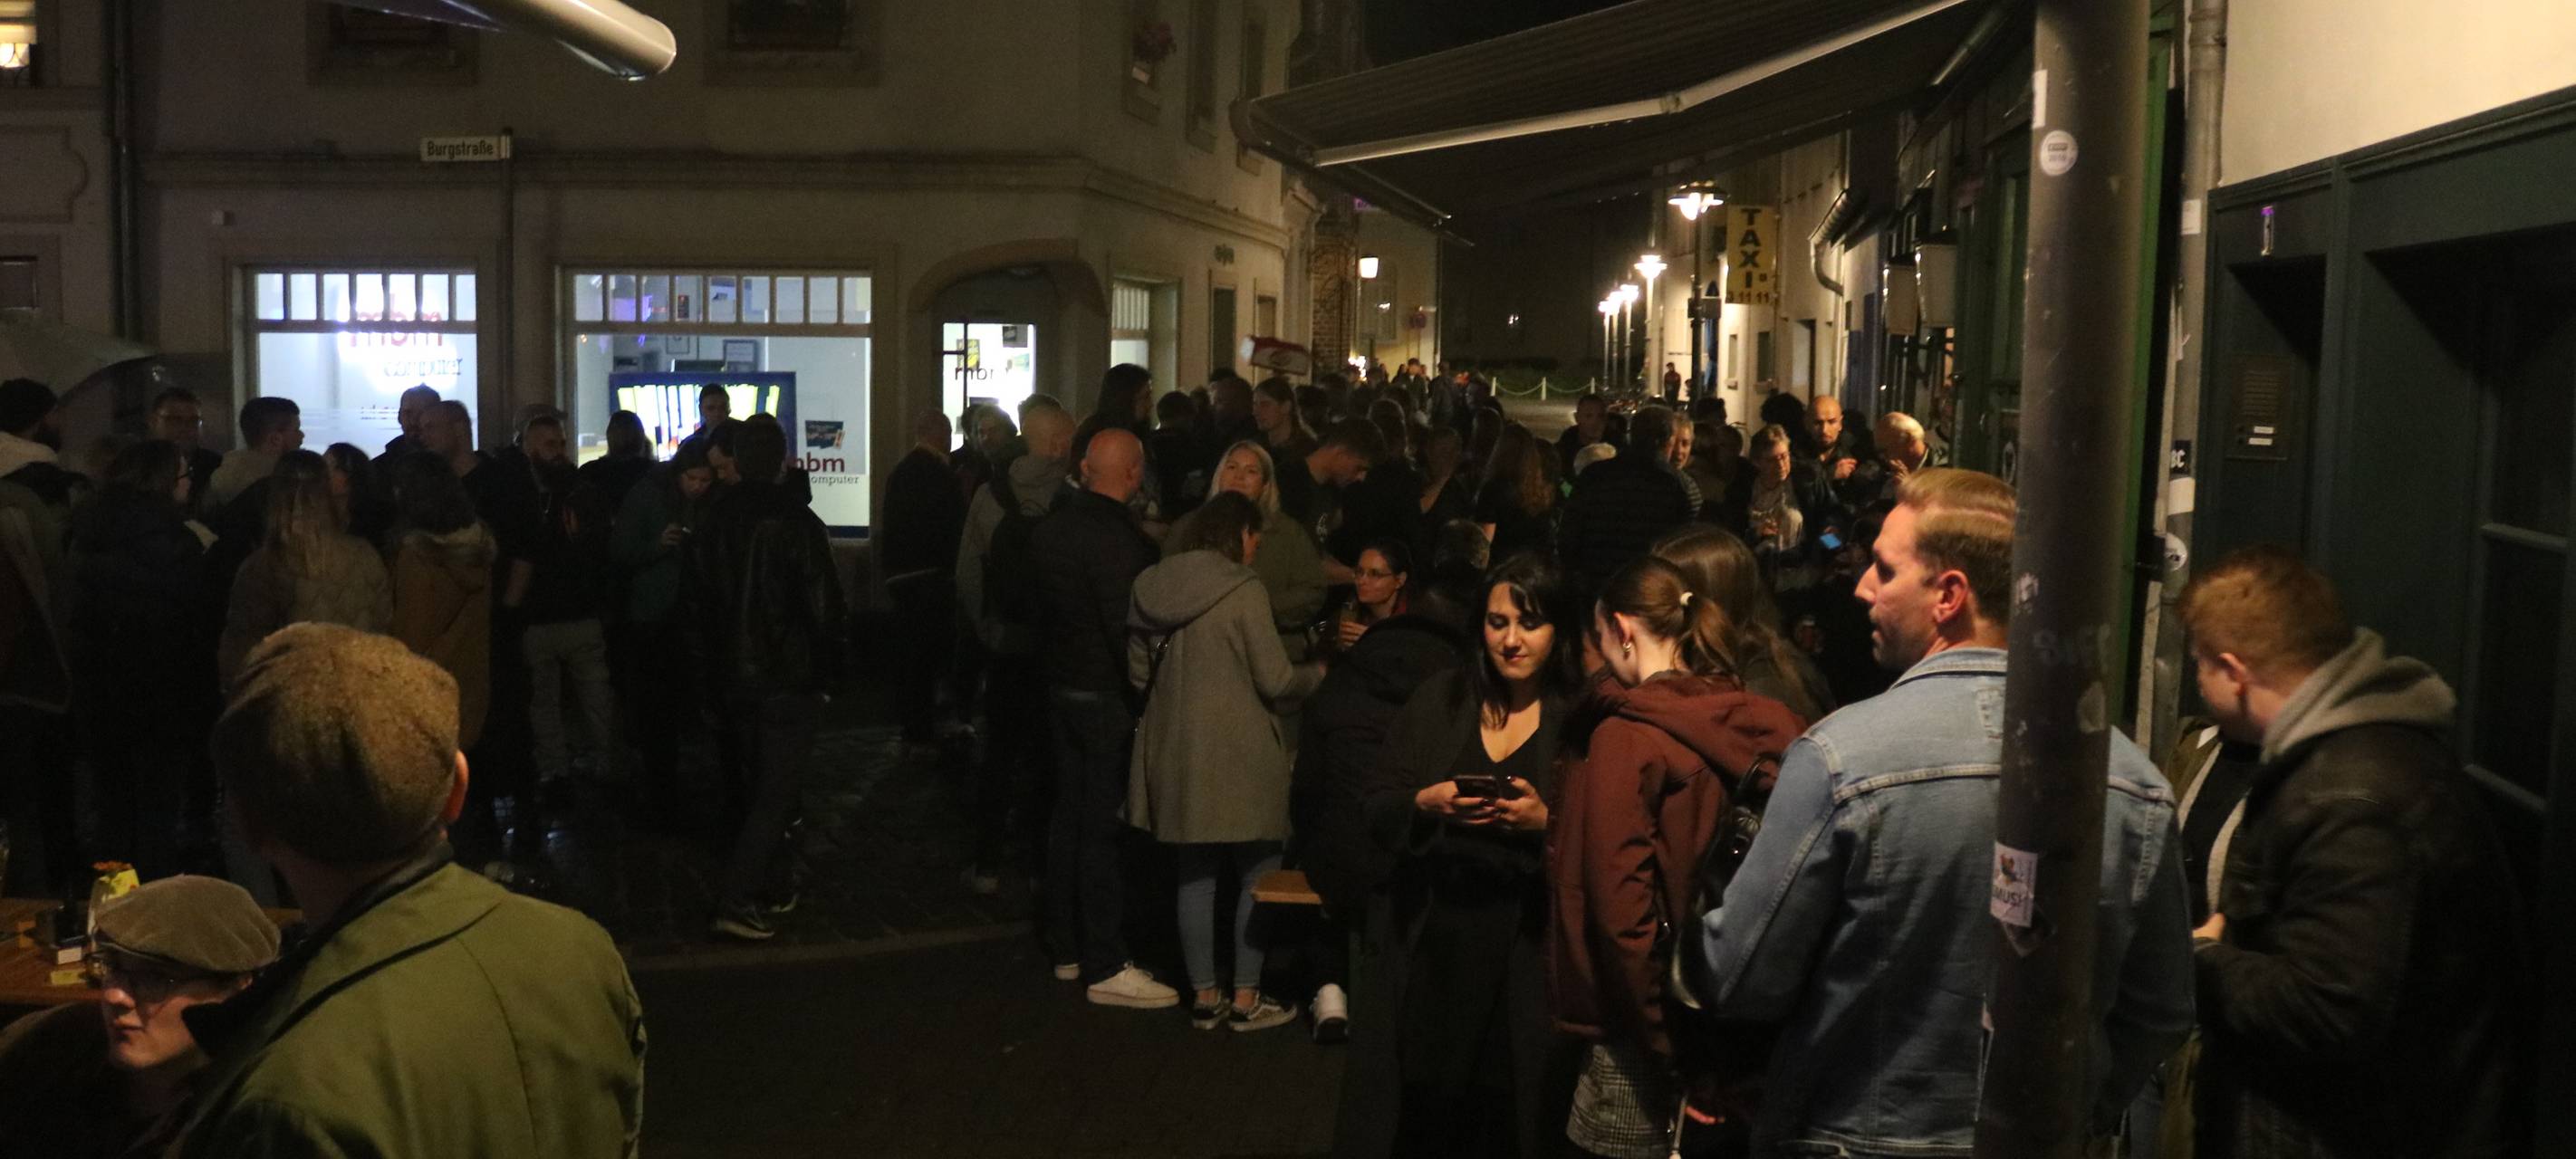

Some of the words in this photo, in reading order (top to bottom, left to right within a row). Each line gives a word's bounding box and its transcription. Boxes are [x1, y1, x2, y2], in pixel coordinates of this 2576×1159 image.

[427, 140, 494, 159] Burgstraße
[1739, 208, 1762, 289] TAXI
[810, 475, 860, 486] omputer
